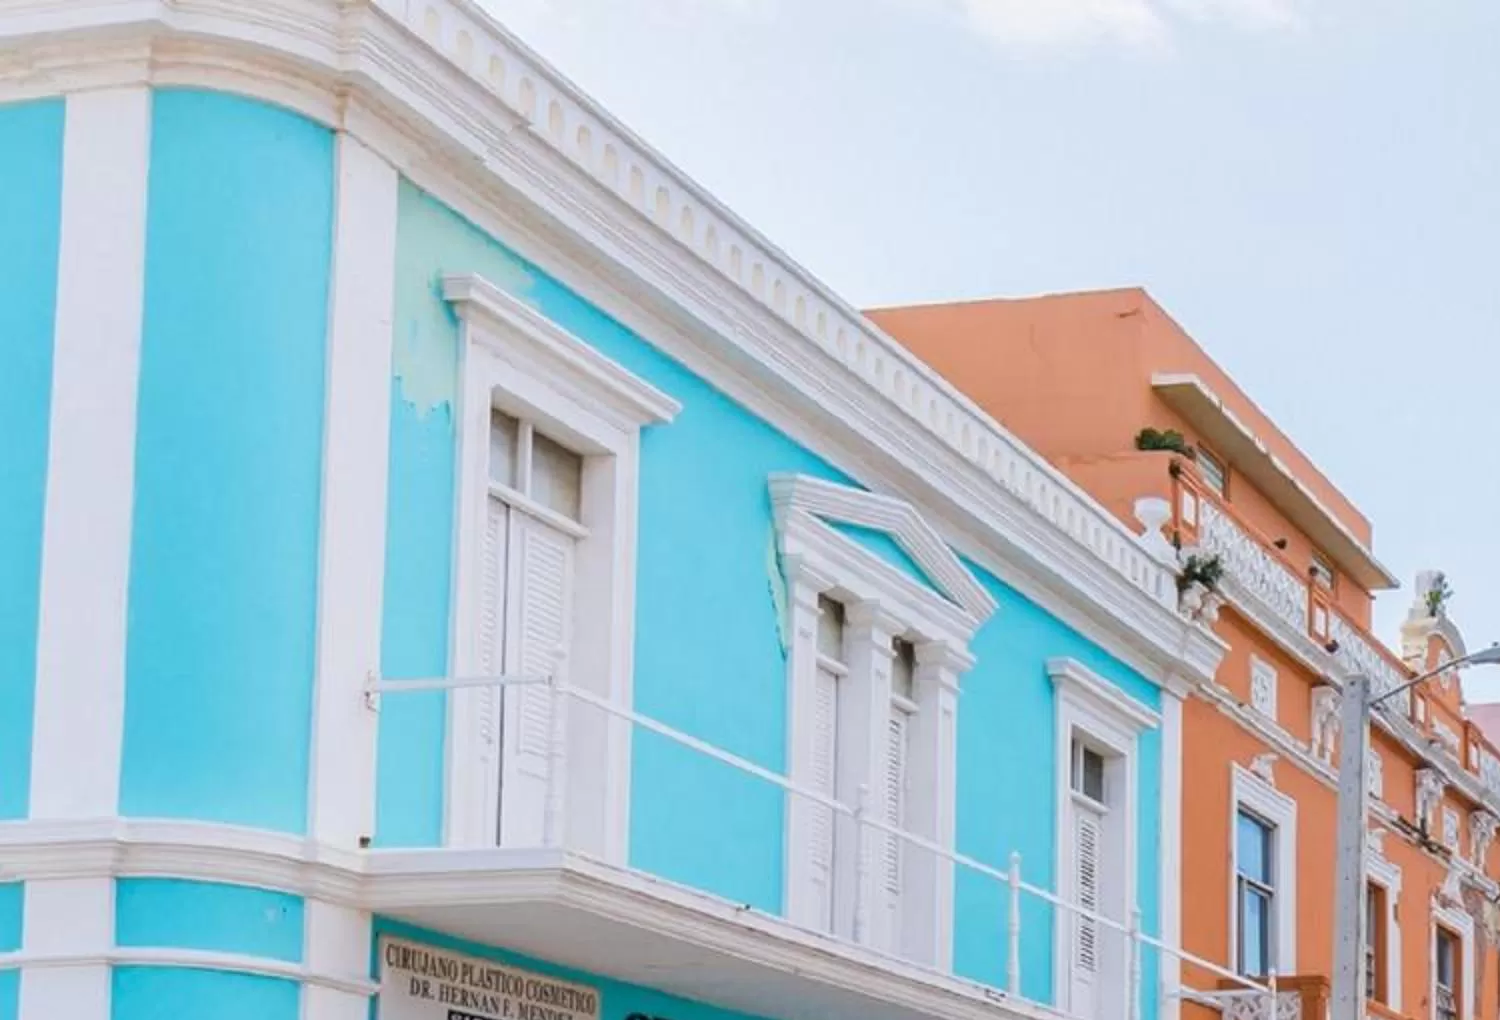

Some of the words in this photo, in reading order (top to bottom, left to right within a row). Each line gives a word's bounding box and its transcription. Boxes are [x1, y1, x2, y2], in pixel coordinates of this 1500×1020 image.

[385, 943, 458, 985] CIRUJANO
[460, 962, 524, 997] PLASTICO
[525, 979, 596, 1015] COSMETICO
[409, 977, 435, 1000] DR.
[439, 983, 500, 1014] HERNAN
